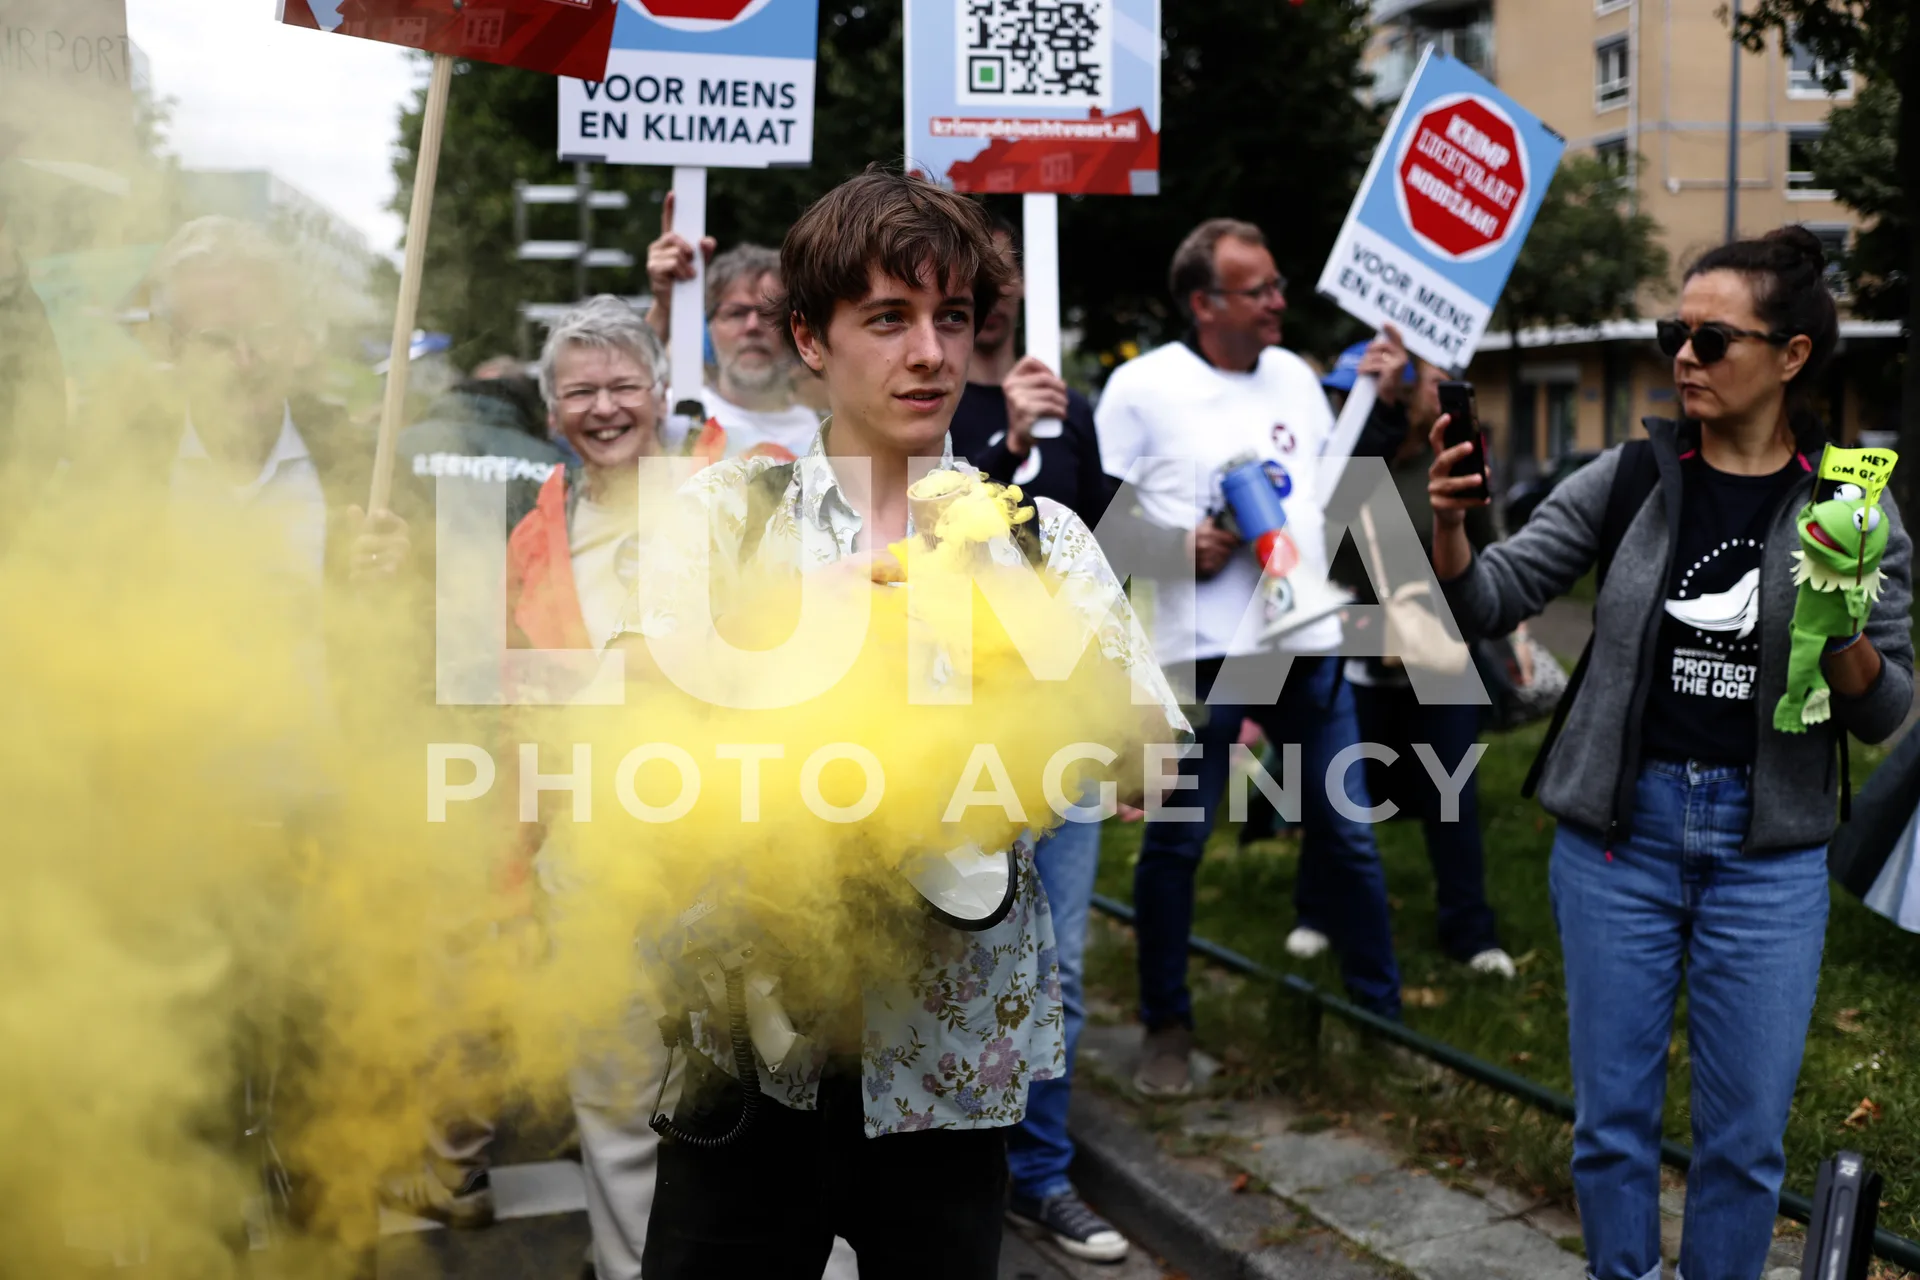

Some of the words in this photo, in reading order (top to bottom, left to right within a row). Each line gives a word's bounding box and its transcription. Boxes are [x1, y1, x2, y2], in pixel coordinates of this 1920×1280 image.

[0, 26, 129, 82] IRPORT
[582, 74, 684, 103] VOOR
[699, 79, 797, 109] MENS
[580, 111, 628, 139] EN
[644, 113, 797, 144] KLIMAAT
[1445, 114, 1511, 171] KRIMP
[1353, 242, 1412, 293] VOOR
[1415, 284, 1474, 334] MENS
[1338, 266, 1372, 299] EN
[1374, 289, 1467, 355] KLIMAAT
[1832, 465, 1855, 475] OM
[1861, 455, 1889, 467] HET
[1672, 656, 1758, 683] PROTECT
[1671, 674, 1708, 696] THE
[1712, 679, 1754, 700] OCE
